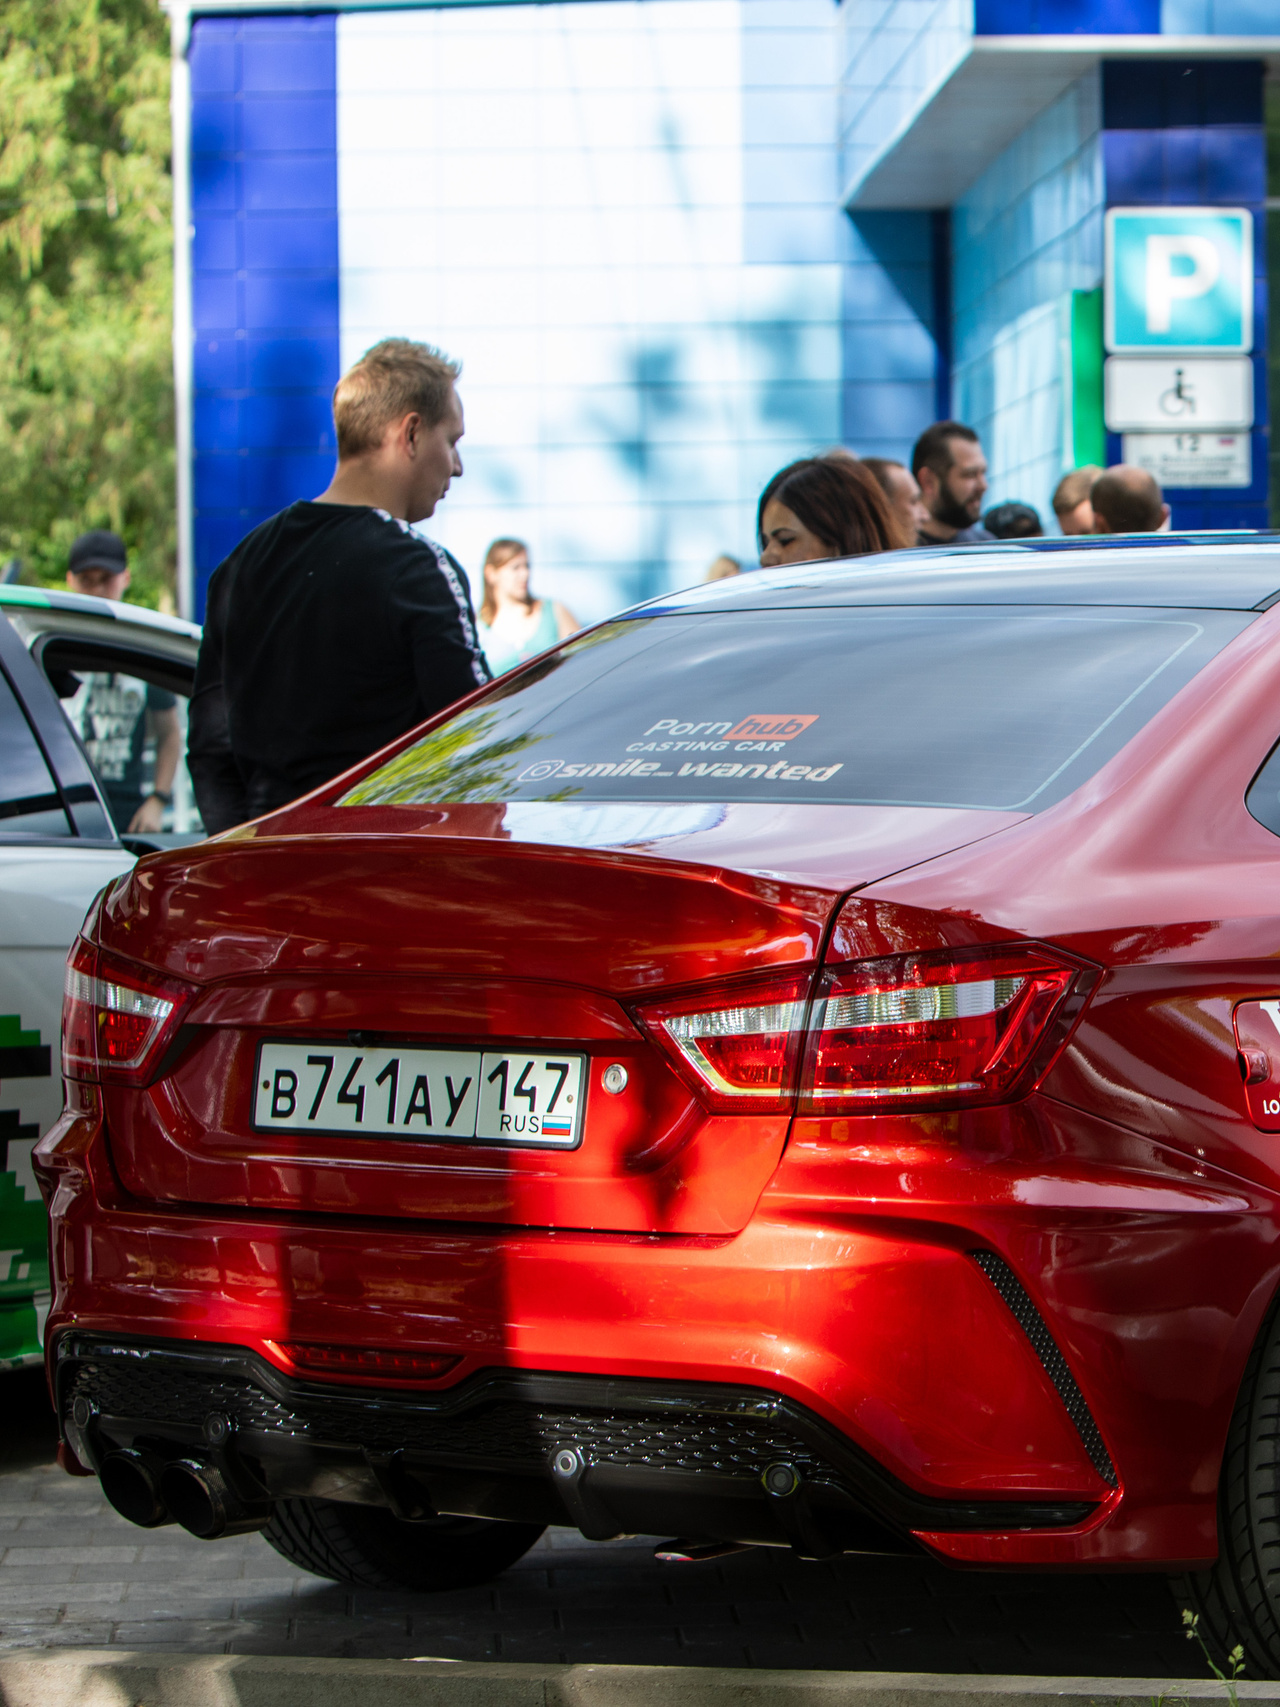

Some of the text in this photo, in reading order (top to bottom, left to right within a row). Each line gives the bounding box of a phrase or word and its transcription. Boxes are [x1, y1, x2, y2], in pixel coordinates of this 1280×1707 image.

[1146, 234, 1221, 334] P
[626, 741, 786, 753] CASTING CAR
[487, 1059, 571, 1113] 147
[500, 1114, 540, 1133] RUS
